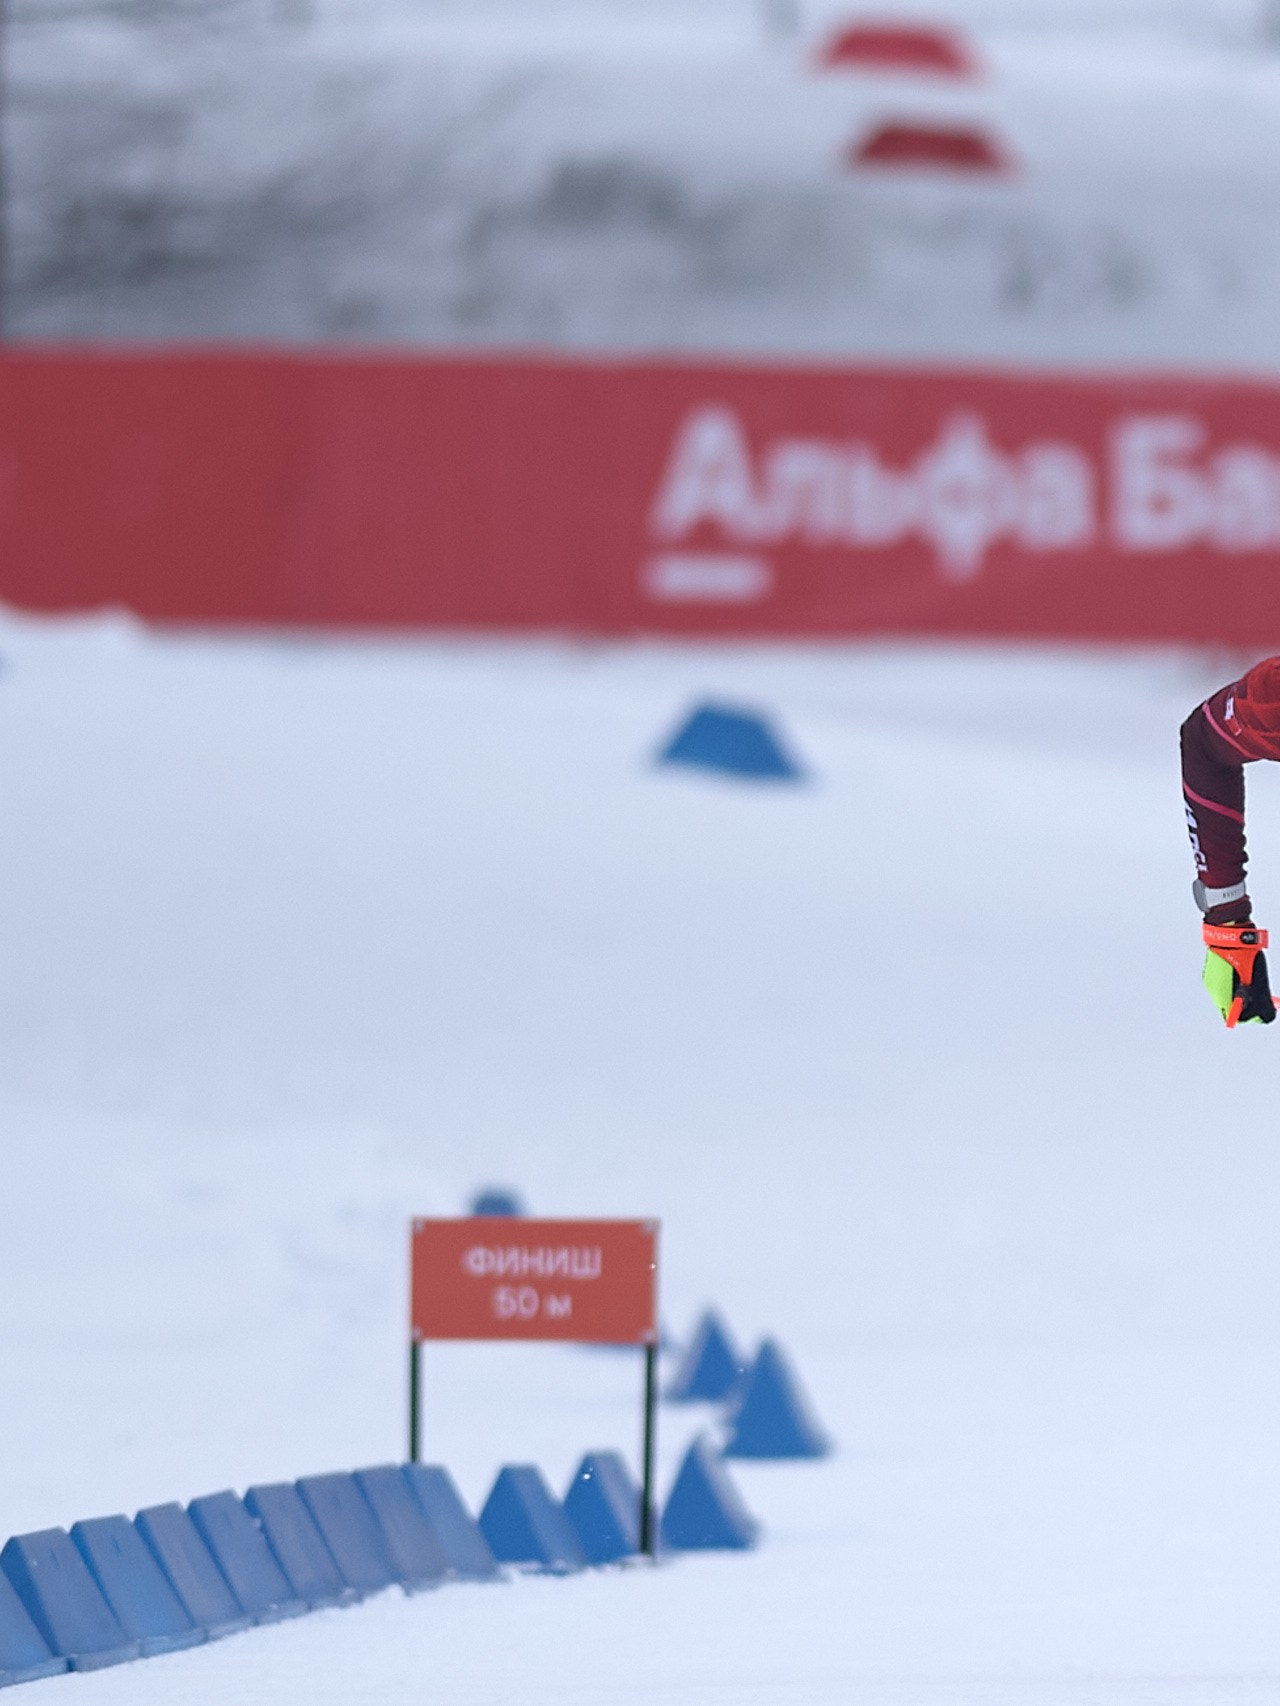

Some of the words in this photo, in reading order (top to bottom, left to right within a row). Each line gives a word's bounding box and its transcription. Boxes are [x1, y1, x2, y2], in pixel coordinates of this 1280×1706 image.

[650, 403, 1092, 580] Альфа
[463, 1246, 602, 1279] ФИНИШ
[493, 1285, 540, 1320] 50
